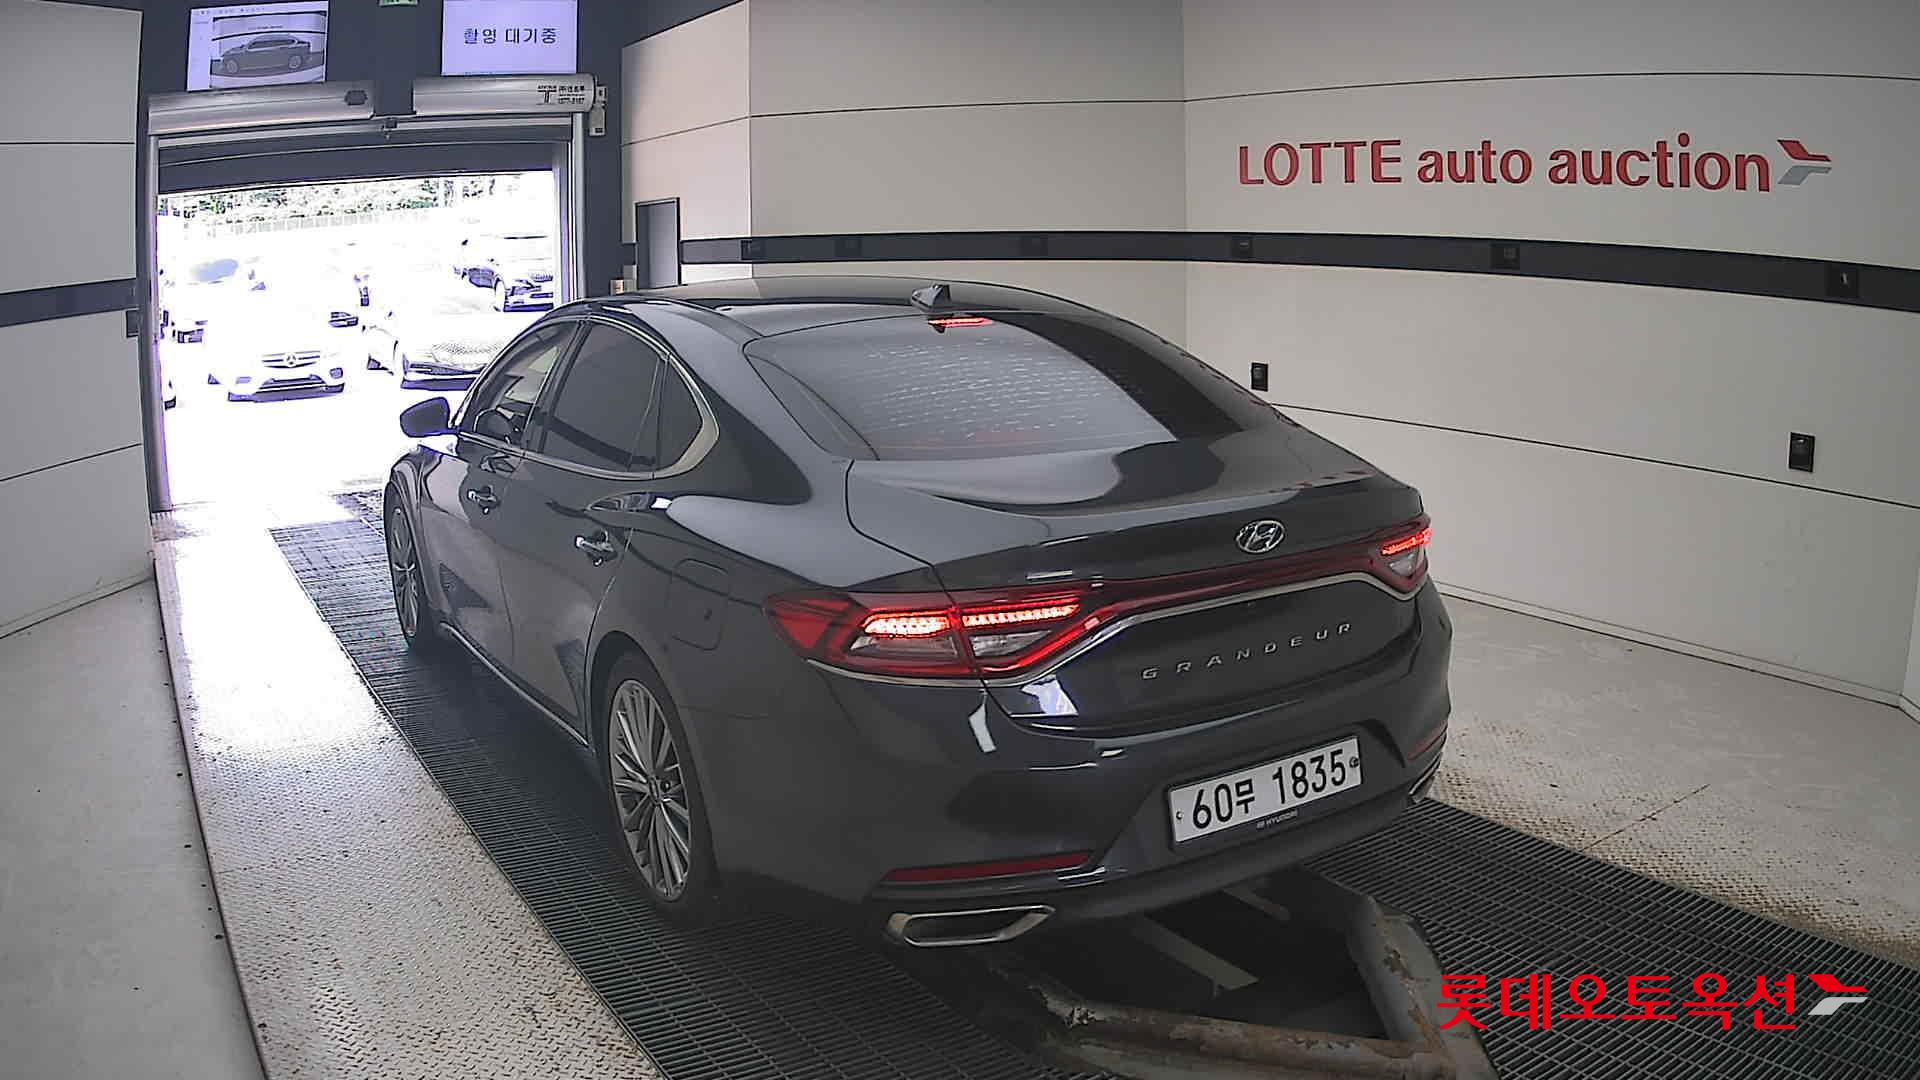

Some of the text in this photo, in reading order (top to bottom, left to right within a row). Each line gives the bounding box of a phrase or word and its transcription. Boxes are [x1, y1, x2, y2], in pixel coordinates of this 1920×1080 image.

[504, 27, 557, 45] 대기중
[1238, 133, 1771, 192] LOTTE auto auction
[1141, 622, 1351, 680] GRANDEUR
[1192, 748, 1347, 829] 60무 1835
